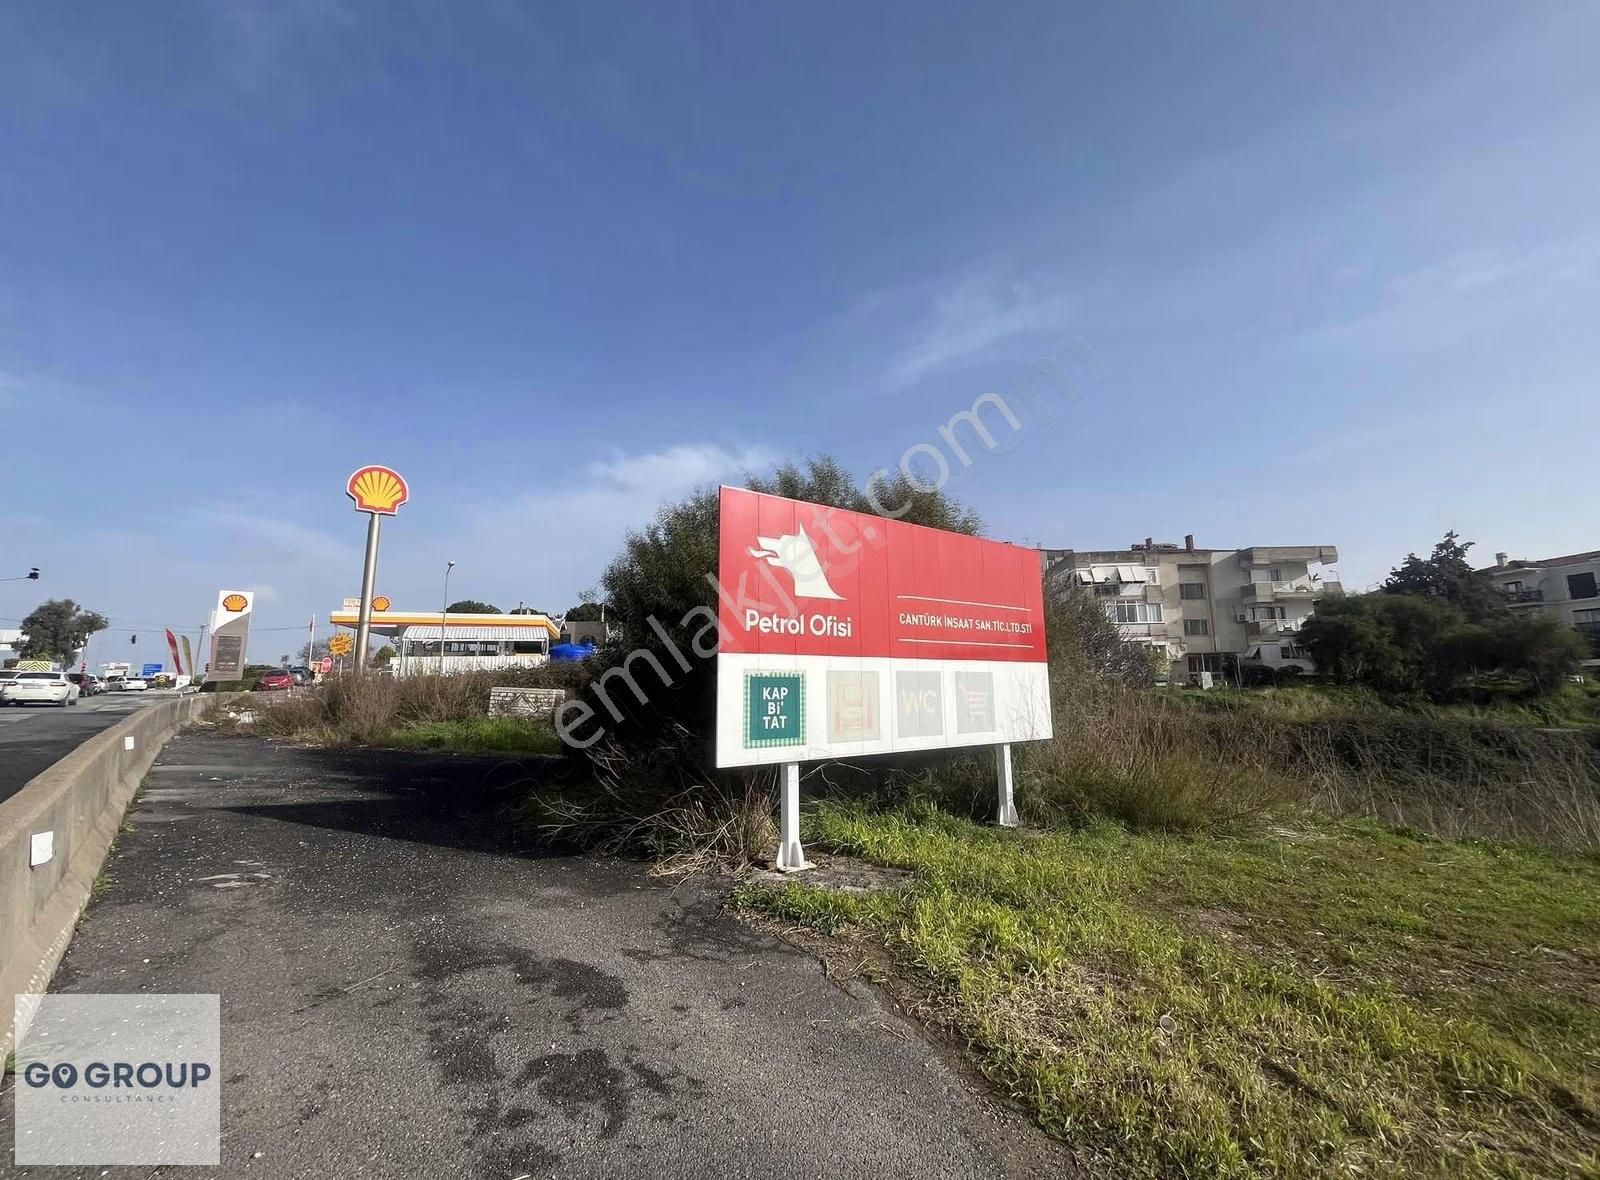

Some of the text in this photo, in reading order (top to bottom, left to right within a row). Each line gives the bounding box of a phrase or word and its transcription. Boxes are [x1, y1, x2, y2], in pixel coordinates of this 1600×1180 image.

[745, 608, 853, 639] Petrol Ofisi
[899, 612, 942, 627] CANTÜRK
[762, 686, 788, 701] KAP
[902, 689, 937, 714] WC
[762, 715, 787, 730] TAT
